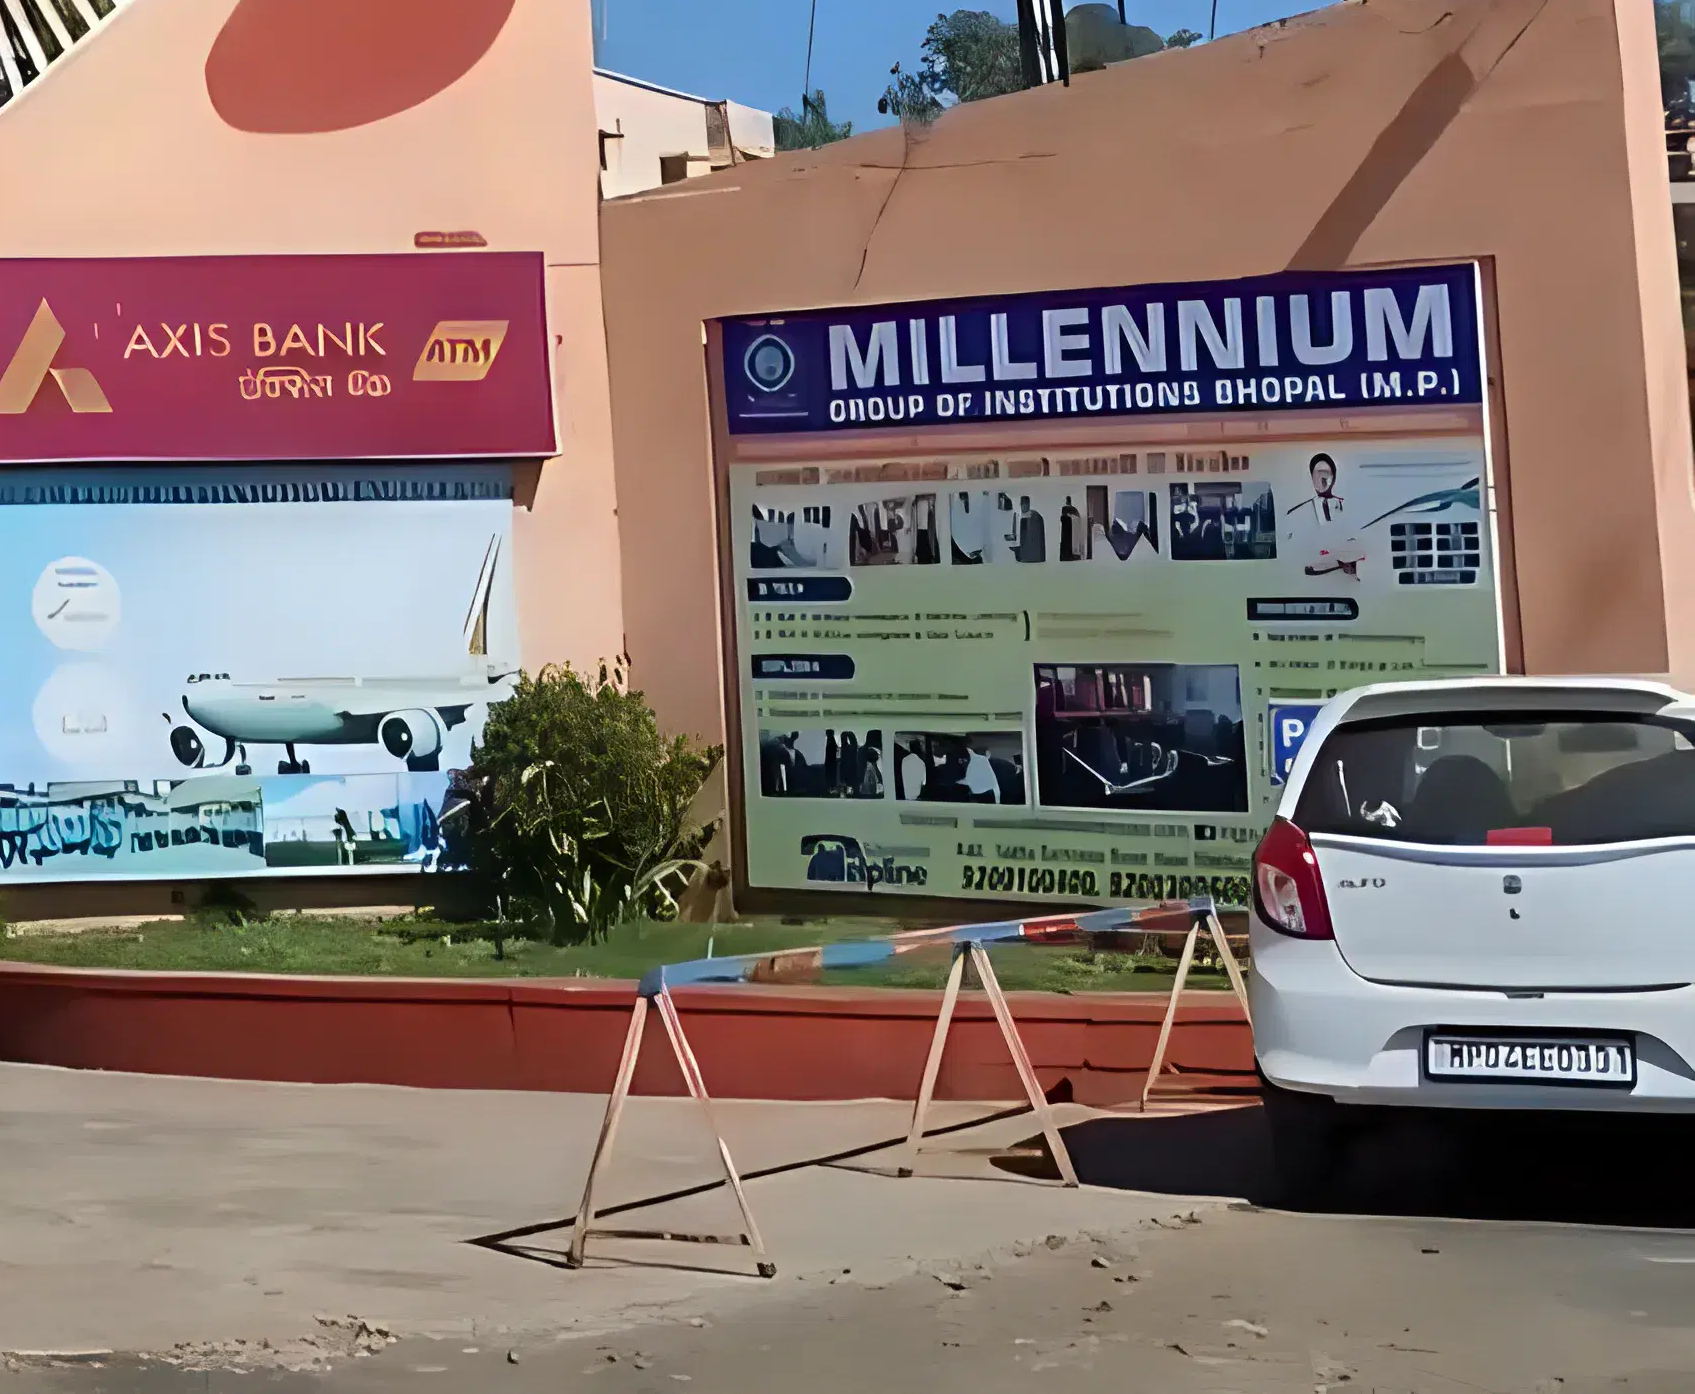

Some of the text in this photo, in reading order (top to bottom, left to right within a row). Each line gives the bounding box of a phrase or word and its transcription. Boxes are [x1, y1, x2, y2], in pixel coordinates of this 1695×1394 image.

[124, 321, 386, 358] AXIS BANK
[426, 338, 491, 364] ATM
[829, 284, 1452, 390] MILLENNIUM
[984, 381, 1200, 416] INSTITUTIONS
